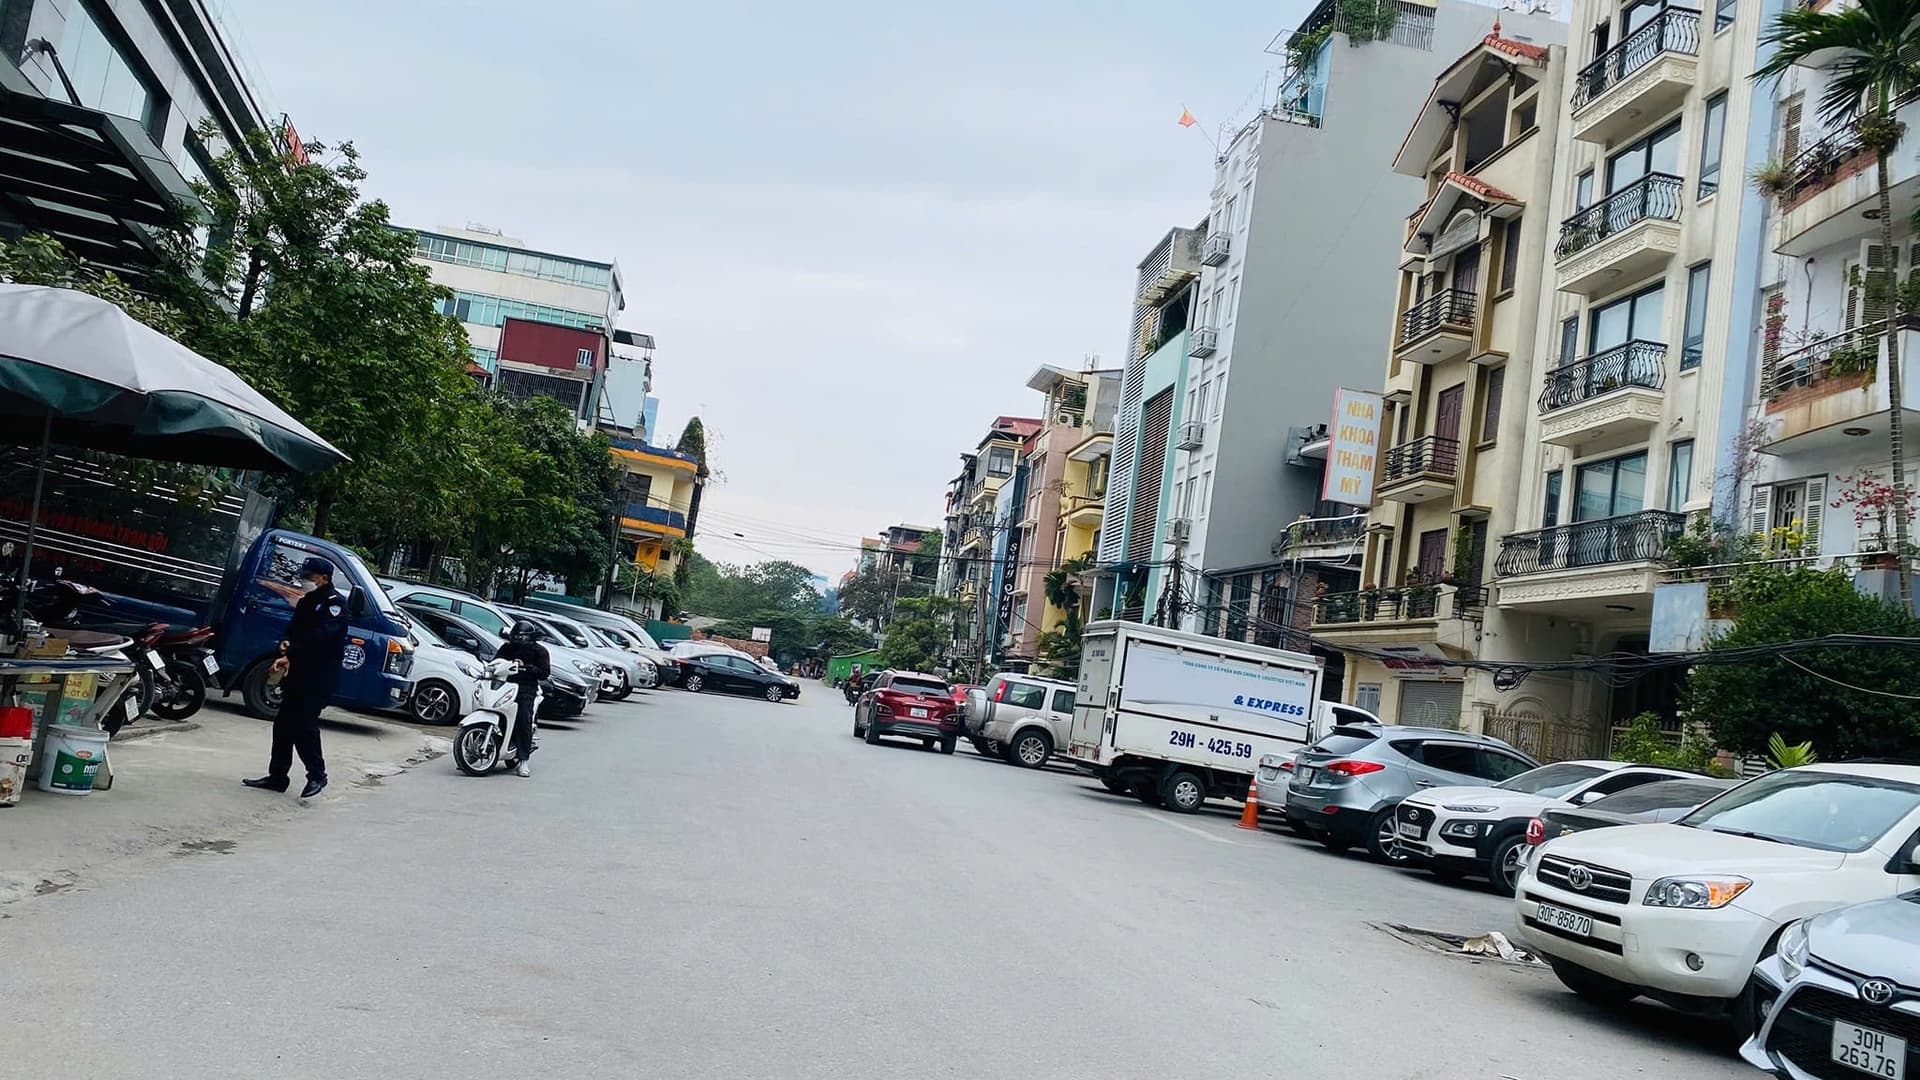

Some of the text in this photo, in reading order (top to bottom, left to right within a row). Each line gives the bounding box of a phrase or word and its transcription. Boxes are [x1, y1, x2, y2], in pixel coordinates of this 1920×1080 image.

[1347, 400, 1374, 420] NHA
[1339, 424, 1374, 446] KHOA
[1233, 695, 1304, 716] & EXPRESS
[1169, 730, 1196, 748] 29H
[1207, 737, 1252, 758] 425.59
[1852, 1028, 1885, 1053] 30H
[1839, 1044, 1896, 1077] 263.76
